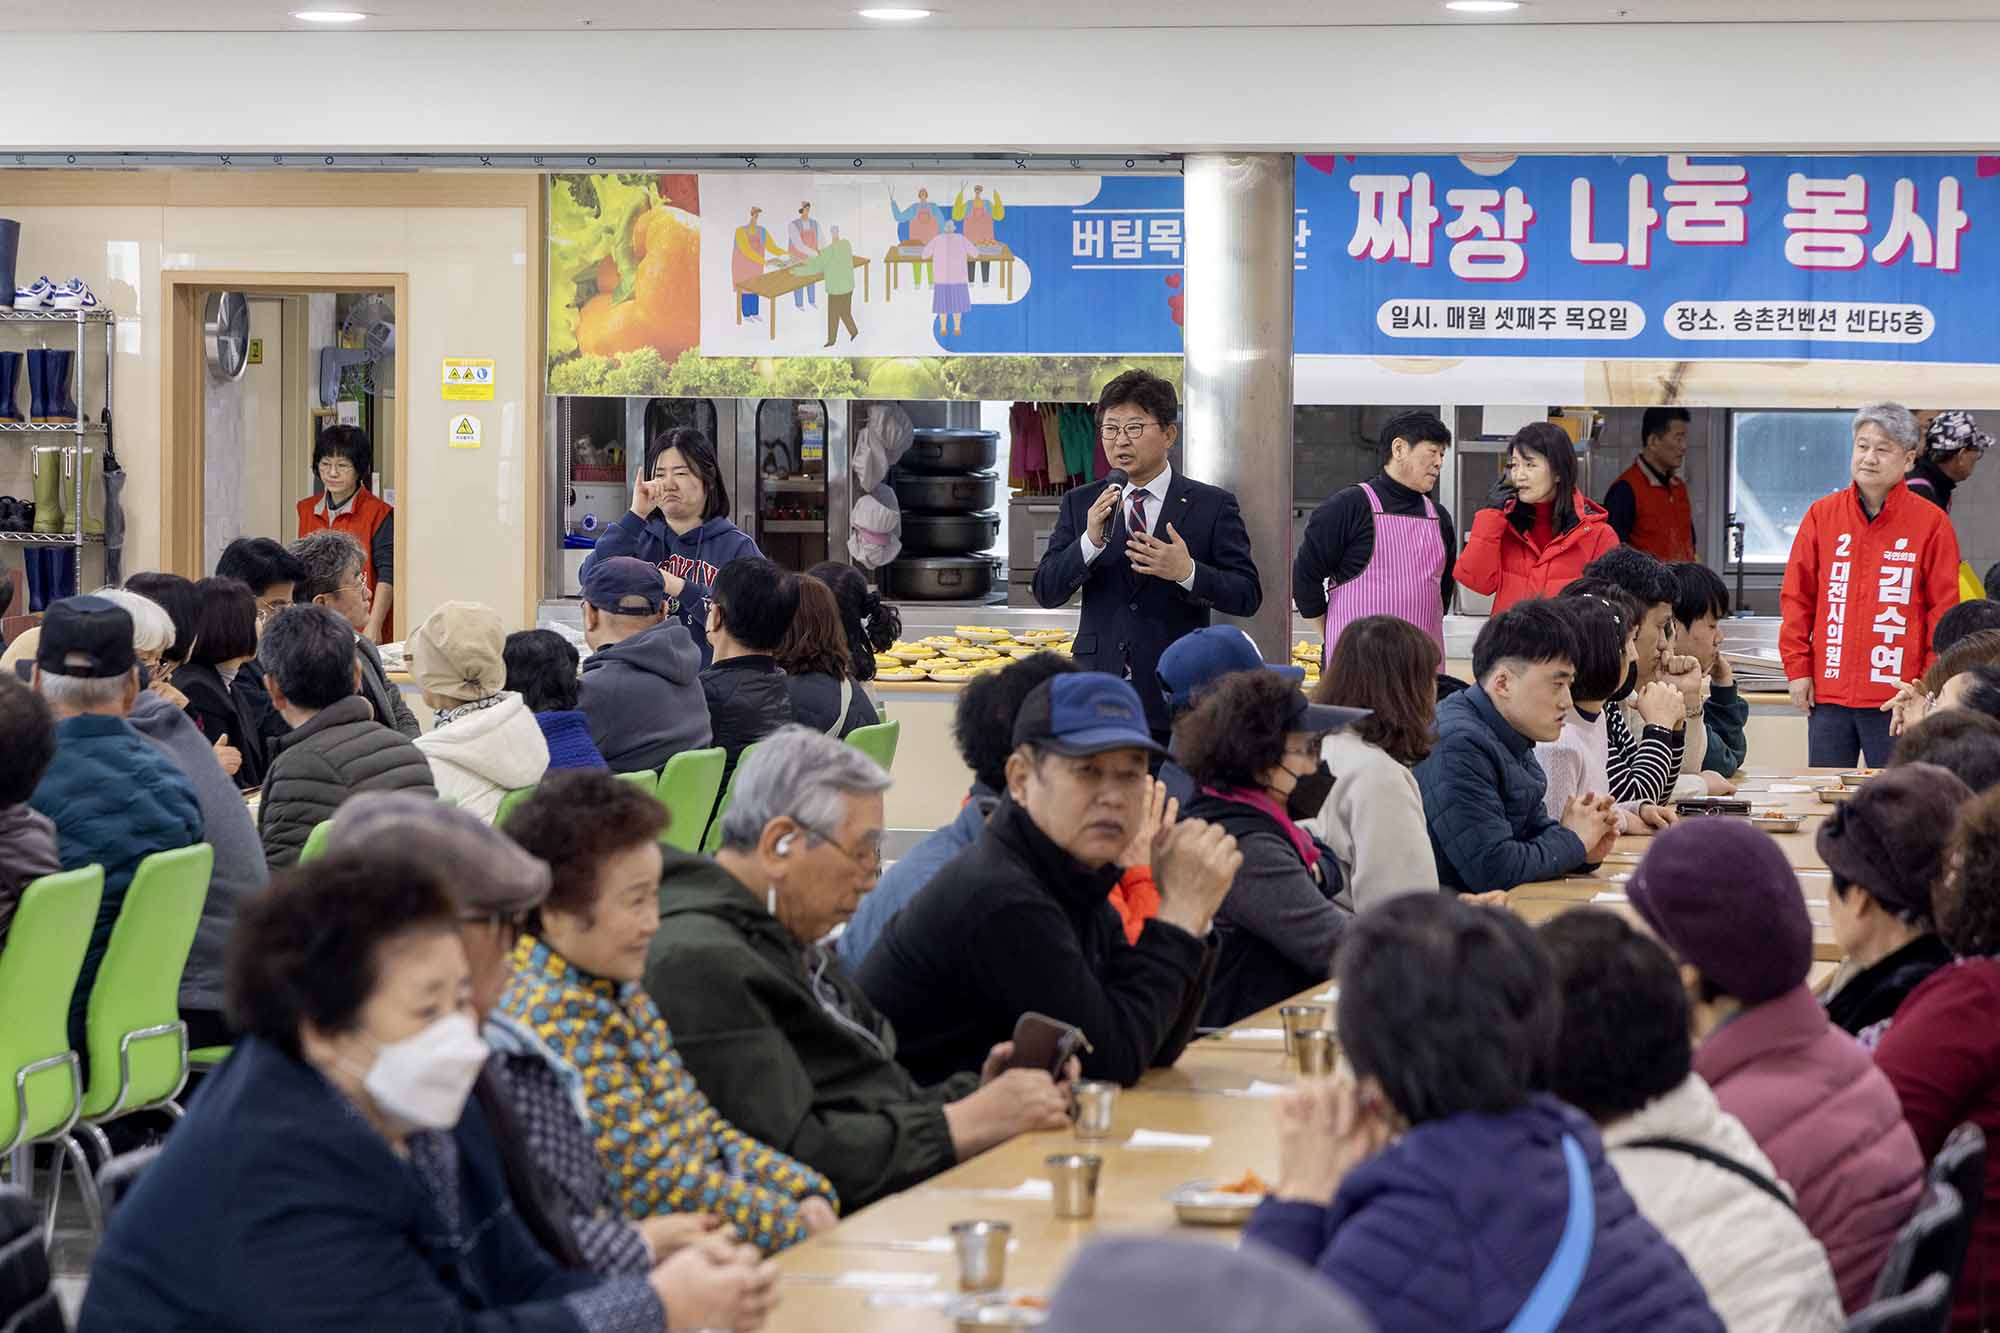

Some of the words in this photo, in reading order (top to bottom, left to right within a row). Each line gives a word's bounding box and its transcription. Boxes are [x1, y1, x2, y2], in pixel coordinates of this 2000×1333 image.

[1347, 171, 1535, 281] 짜장
[1570, 155, 1750, 268] 나눔
[1782, 172, 1969, 273] 봉사
[1073, 219, 1183, 259] 버팀목
[1391, 305, 1438, 330] 일시.
[1446, 305, 1487, 330] 매월
[1494, 306, 1557, 331] 셋째주
[1565, 307, 1628, 331] 목요일
[1676, 307, 1726, 332] 장소.
[1733, 306, 1838, 333] 송촌컨벤션
[1845, 308, 1925, 335] 센타5층
[1835, 533, 1852, 557] 2
[1883, 551, 1916, 562] 국민의힘
[1826, 562, 1850, 666] 대전시의원
[1871, 566, 1913, 683] 김수연
